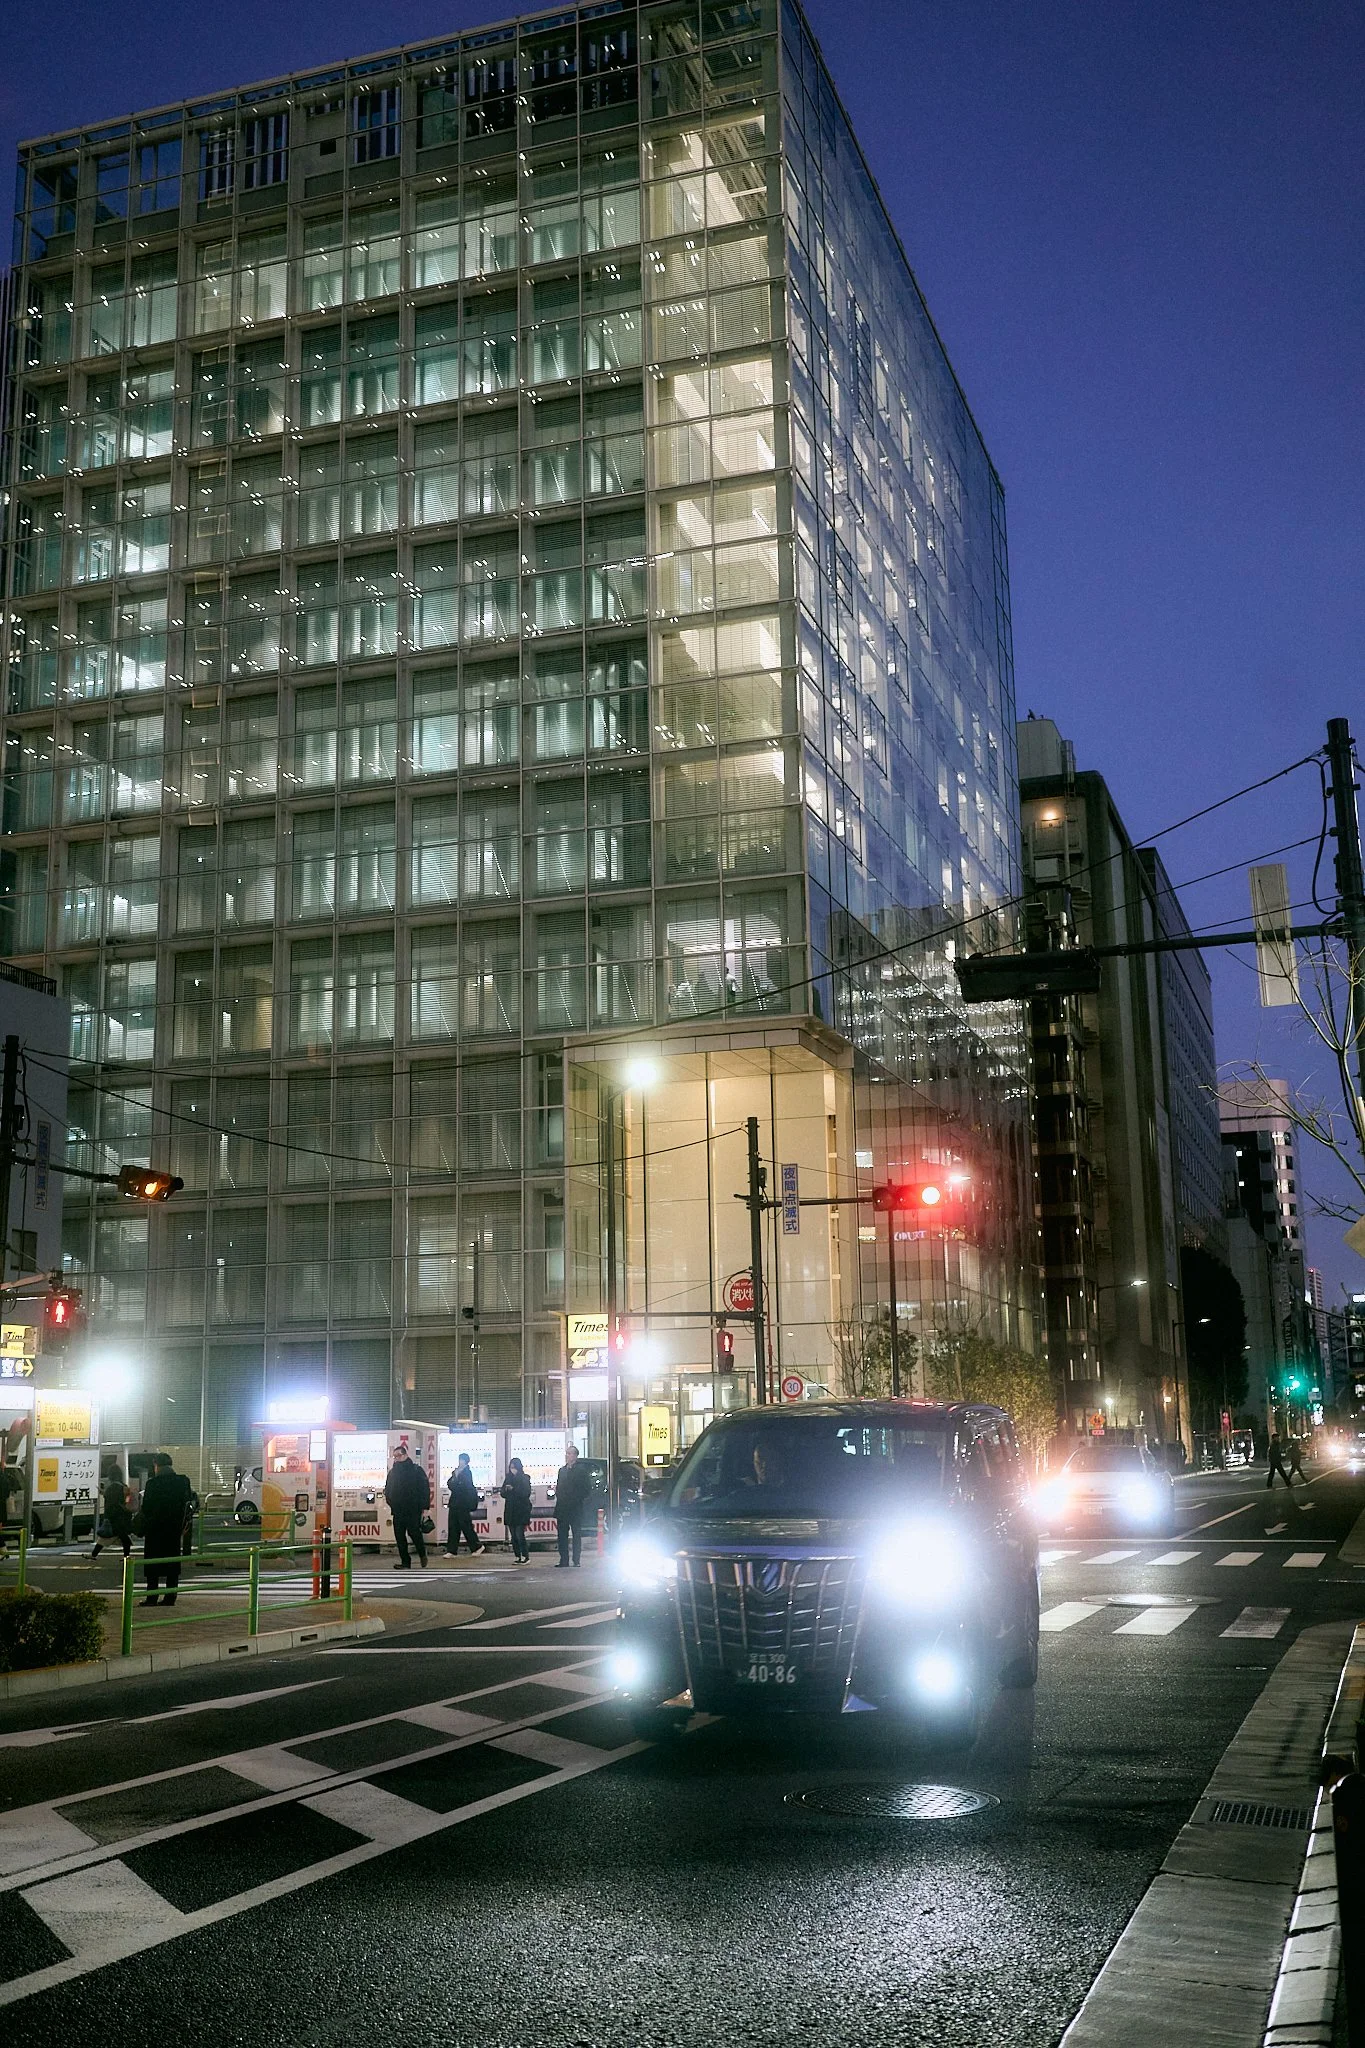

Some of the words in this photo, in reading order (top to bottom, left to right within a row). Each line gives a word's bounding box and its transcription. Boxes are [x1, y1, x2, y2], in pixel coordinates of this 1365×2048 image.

[783, 1167, 797, 1231] 夜間点滅式
[573, 1321, 609, 1333] Times
[786, 1382, 799, 1393] 30
[648, 1423, 668, 1439] Times
[65, 1459, 93, 1468] カーシェア
[62, 1471, 95, 1479] ステーション
[345, 1524, 381, 1536] KIRIN
[747, 1664, 797, 1684] 40-86
